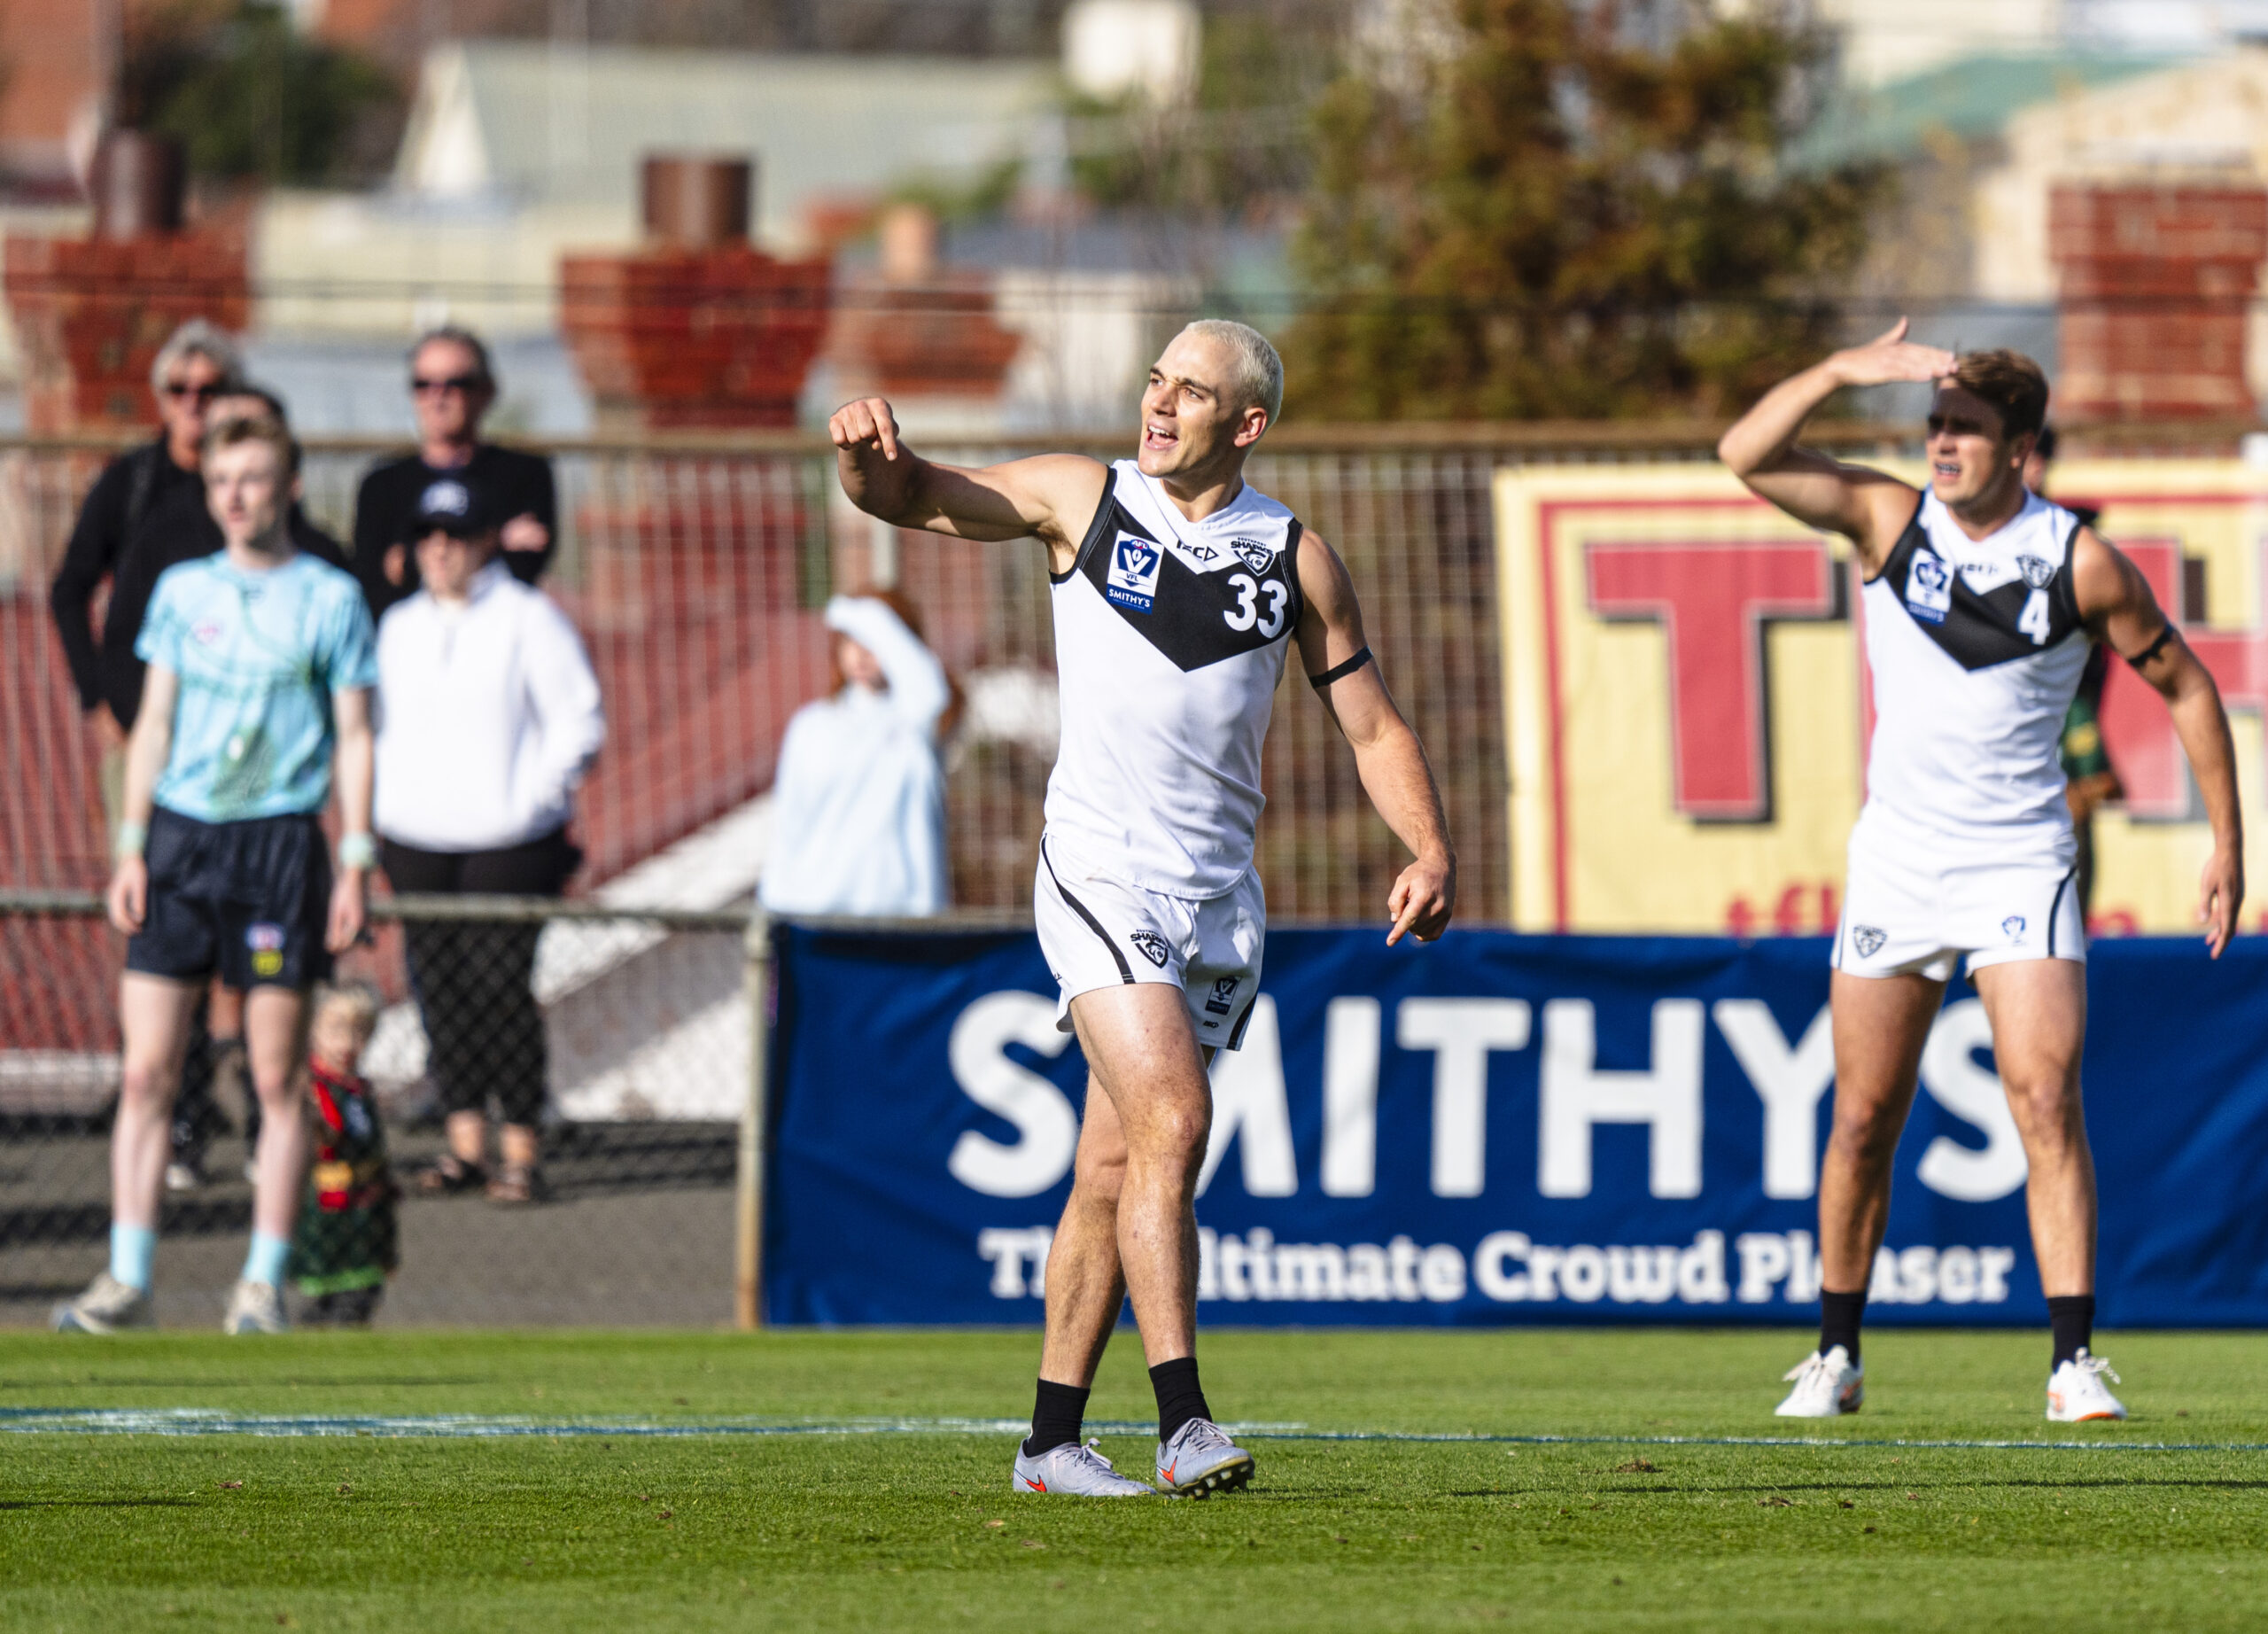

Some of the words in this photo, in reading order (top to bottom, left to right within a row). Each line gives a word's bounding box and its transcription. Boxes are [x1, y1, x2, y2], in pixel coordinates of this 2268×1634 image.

[1130, 540, 1149, 550] AFL
[1108, 588, 1151, 608] SMITHY'S
[1126, 572, 1138, 582] VFL
[1223, 573, 1287, 639] 33
[2017, 588, 2050, 645] 4
[947, 988, 2029, 1202] SITHYS
[1198, 1225, 1468, 1302] ltimate
[1473, 1230, 1730, 1303] Crowd
[1734, 1228, 2016, 1303] Plaser
